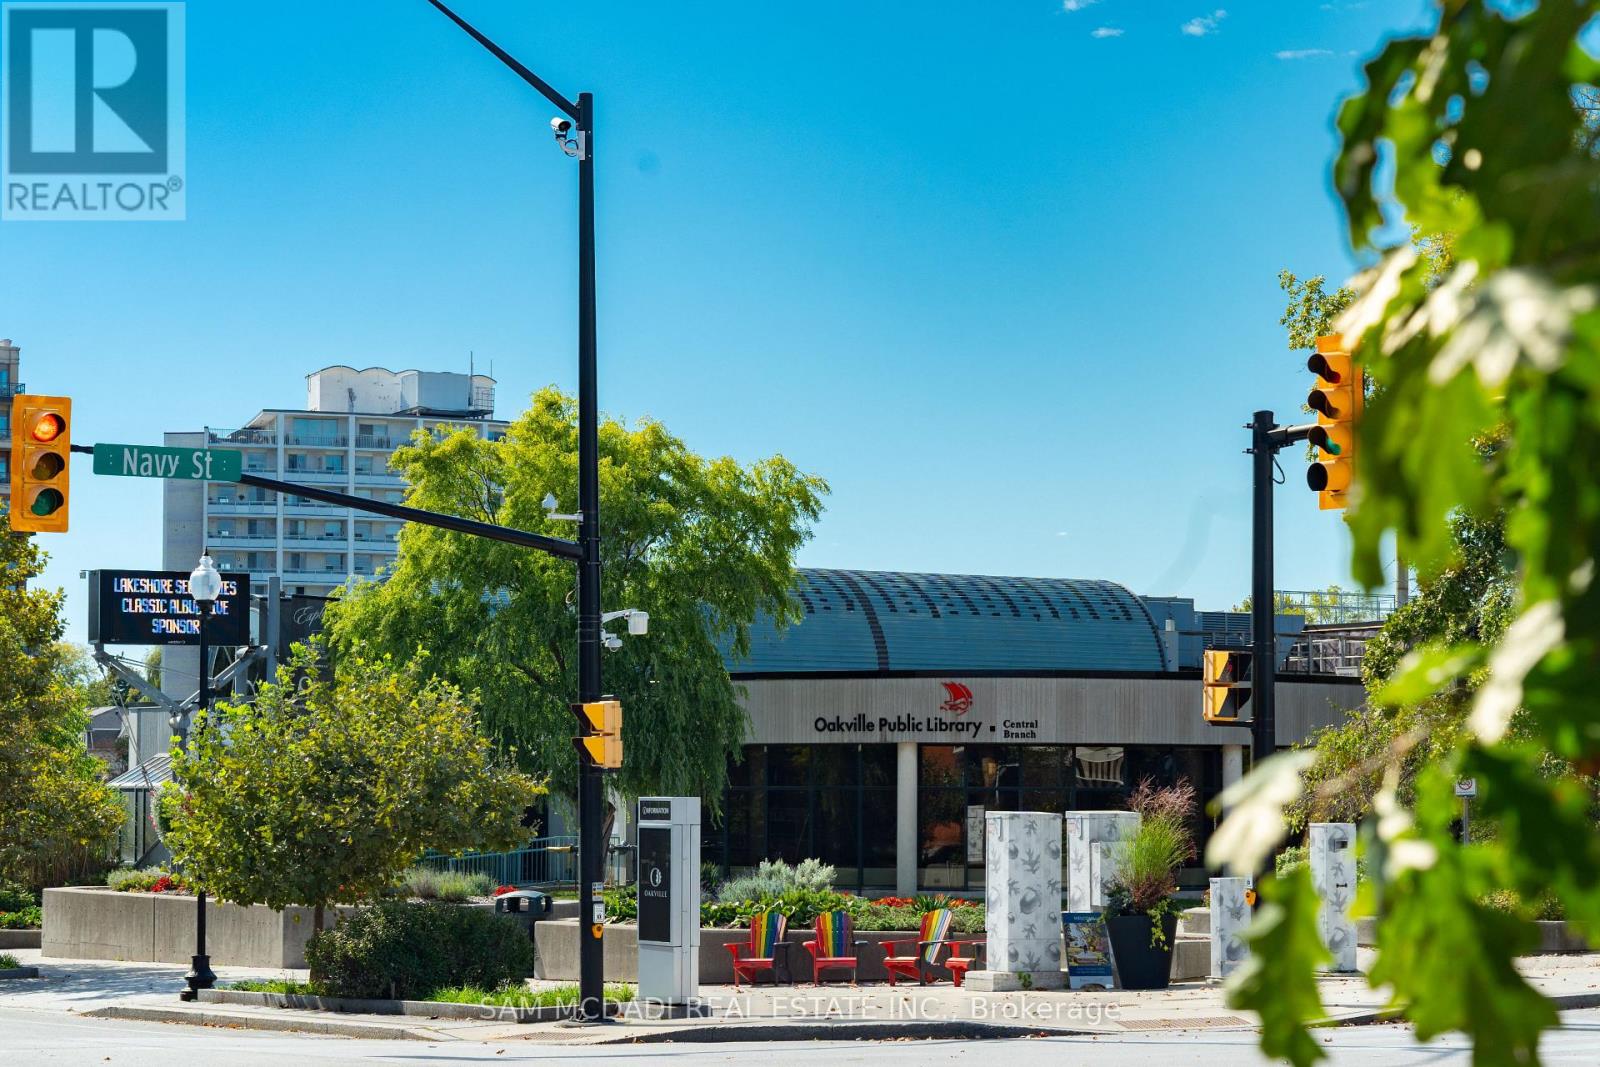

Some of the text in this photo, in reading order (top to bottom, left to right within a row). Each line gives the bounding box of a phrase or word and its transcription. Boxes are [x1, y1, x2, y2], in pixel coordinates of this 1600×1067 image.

[122, 447, 213, 479] Navy St
[113, 577, 173, 594] LAKESHORE
[121, 598, 168, 615] CLASSIC
[151, 618, 201, 634] SPONSOR
[814, 713, 983, 738] Oakville Public Library
[1003, 719, 1039, 729] Central
[1003, 729, 1037, 739] Branch
